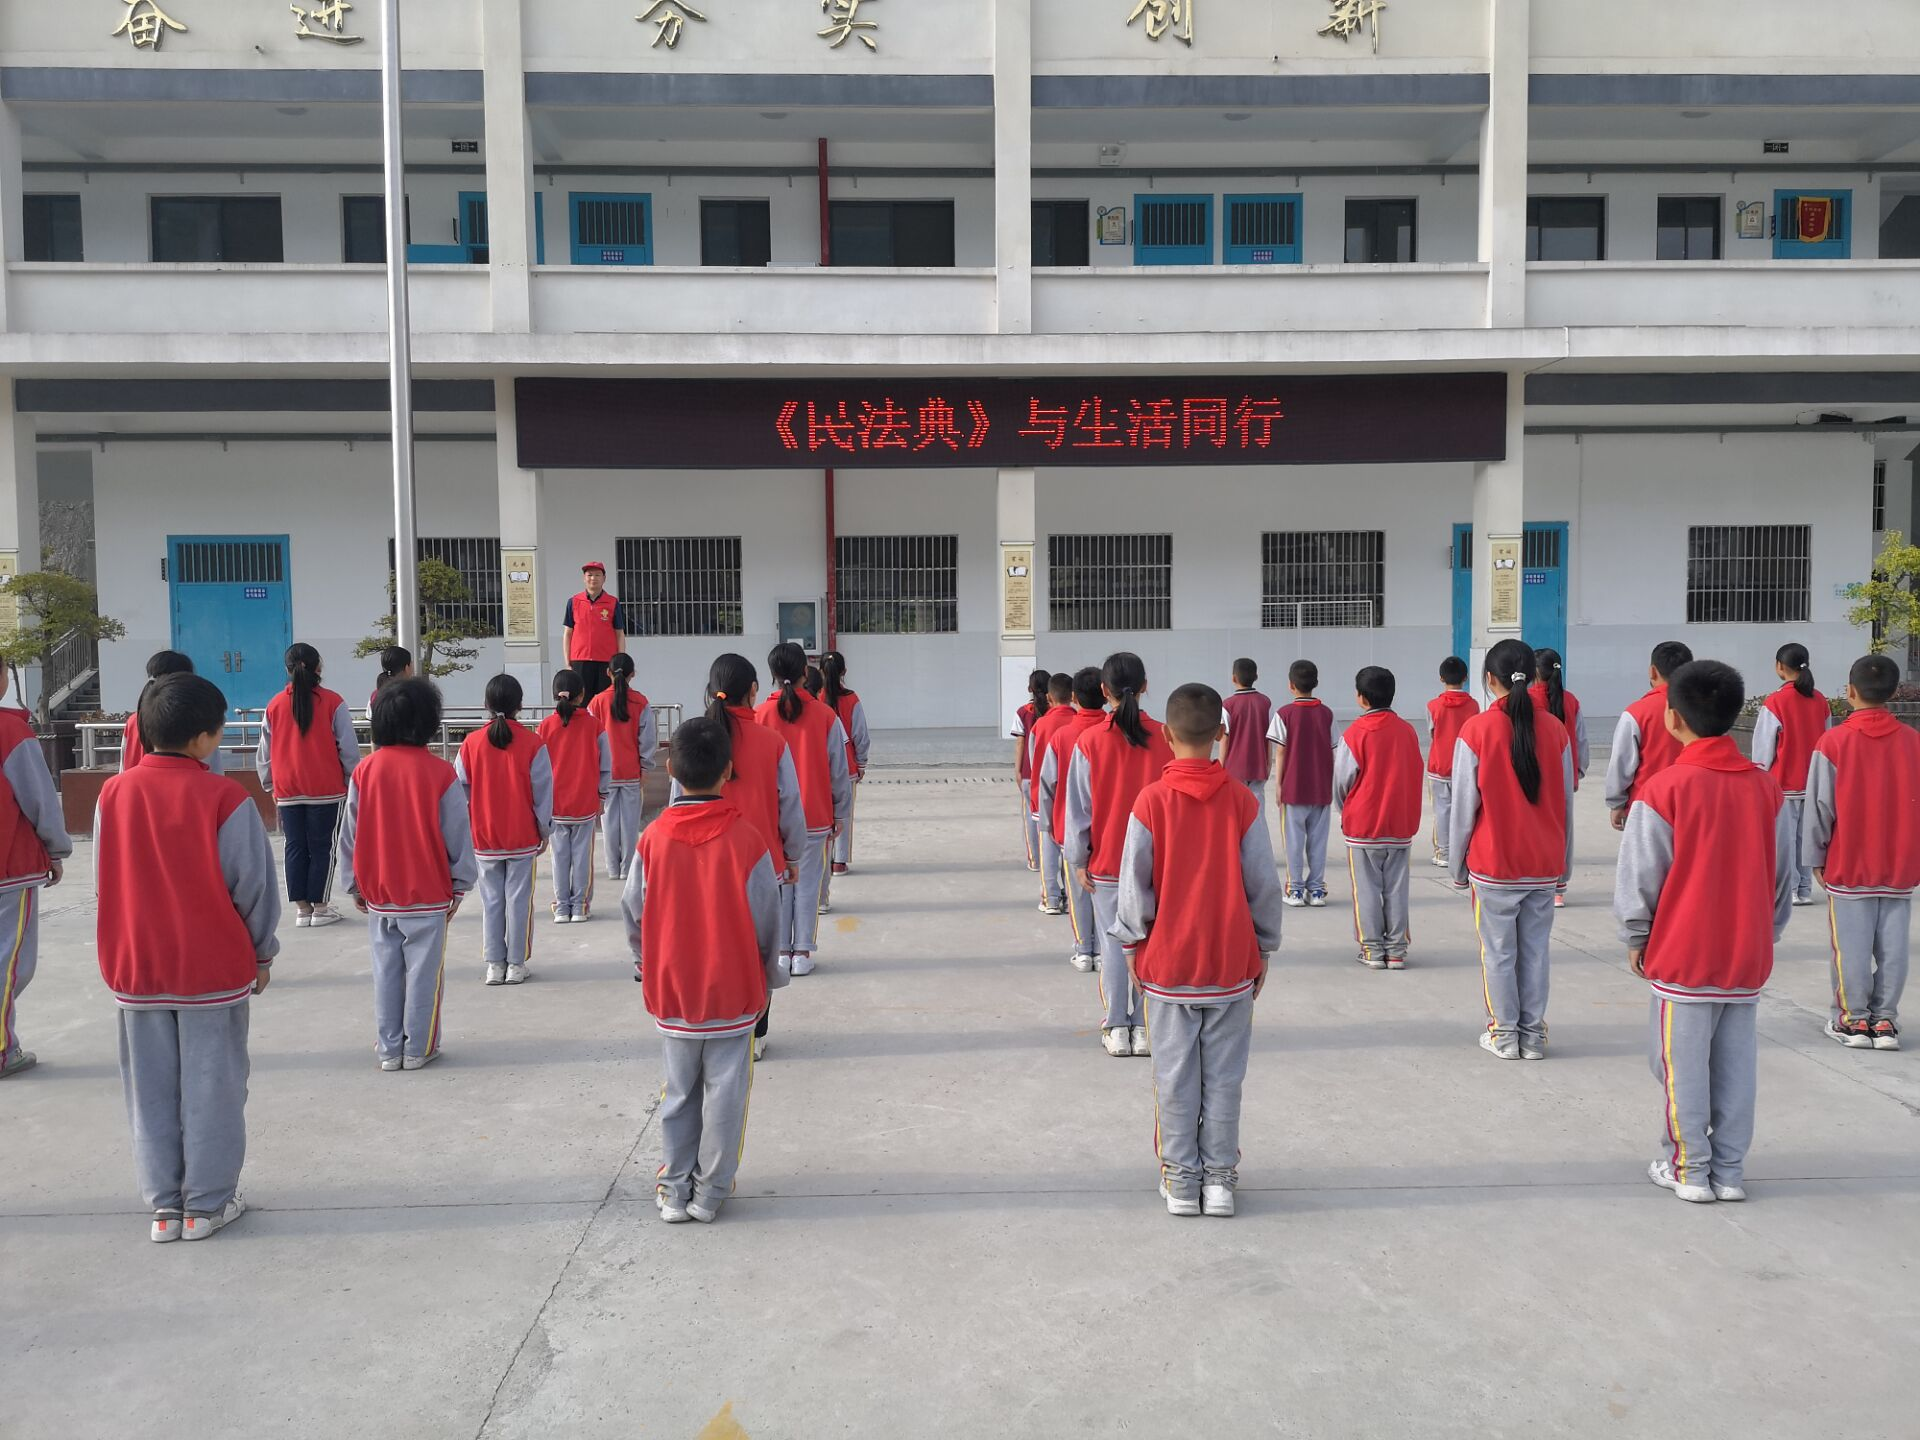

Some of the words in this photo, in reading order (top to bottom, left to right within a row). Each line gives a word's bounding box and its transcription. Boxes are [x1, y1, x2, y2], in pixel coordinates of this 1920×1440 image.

[775, 397, 990, 451] 《民法典》
[1018, 396, 1284, 449] 与生活同行
